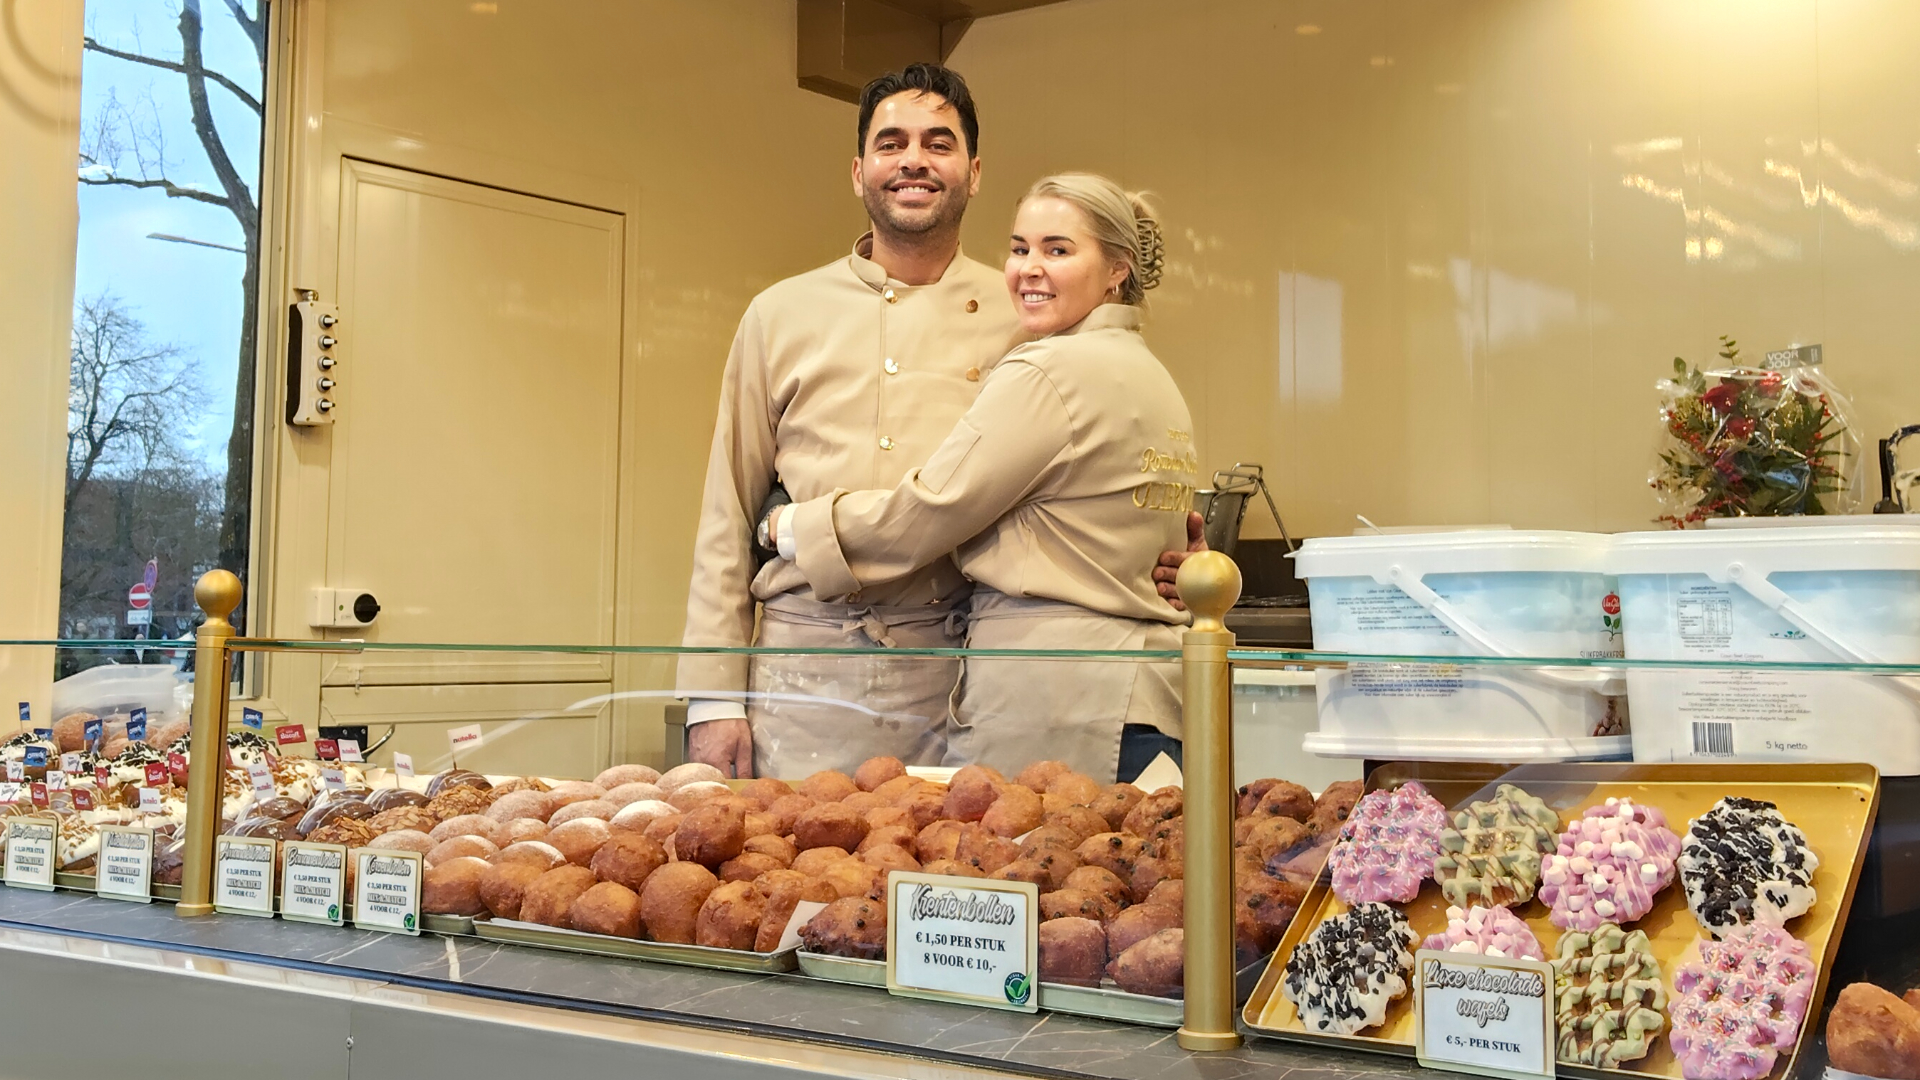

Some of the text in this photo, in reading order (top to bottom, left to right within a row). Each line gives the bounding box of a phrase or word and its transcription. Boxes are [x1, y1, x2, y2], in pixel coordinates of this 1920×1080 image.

[1767, 350, 1799, 361] VOOR
[1767, 359, 1791, 369] JOU
[453, 733, 478, 744] nutella
[1774, 741, 1785, 752] kg
[1786, 742, 1808, 750] netto
[307, 875, 318, 883] PER
[318, 876, 331, 884] STUK
[382, 883, 393, 891] PER
[393, 884, 407, 892] STUK
[910, 882, 1015, 925] Krentenbollen
[916, 932, 1006, 952] € 1,50 PER STUK
[923, 952, 997, 973] 8 VOOR € 10,-
[1424, 959, 1545, 998] Luxe chocolade
[1456, 996, 1510, 1028] wafels
[1446, 1035, 1521, 1053] € 5,- PER STUK
